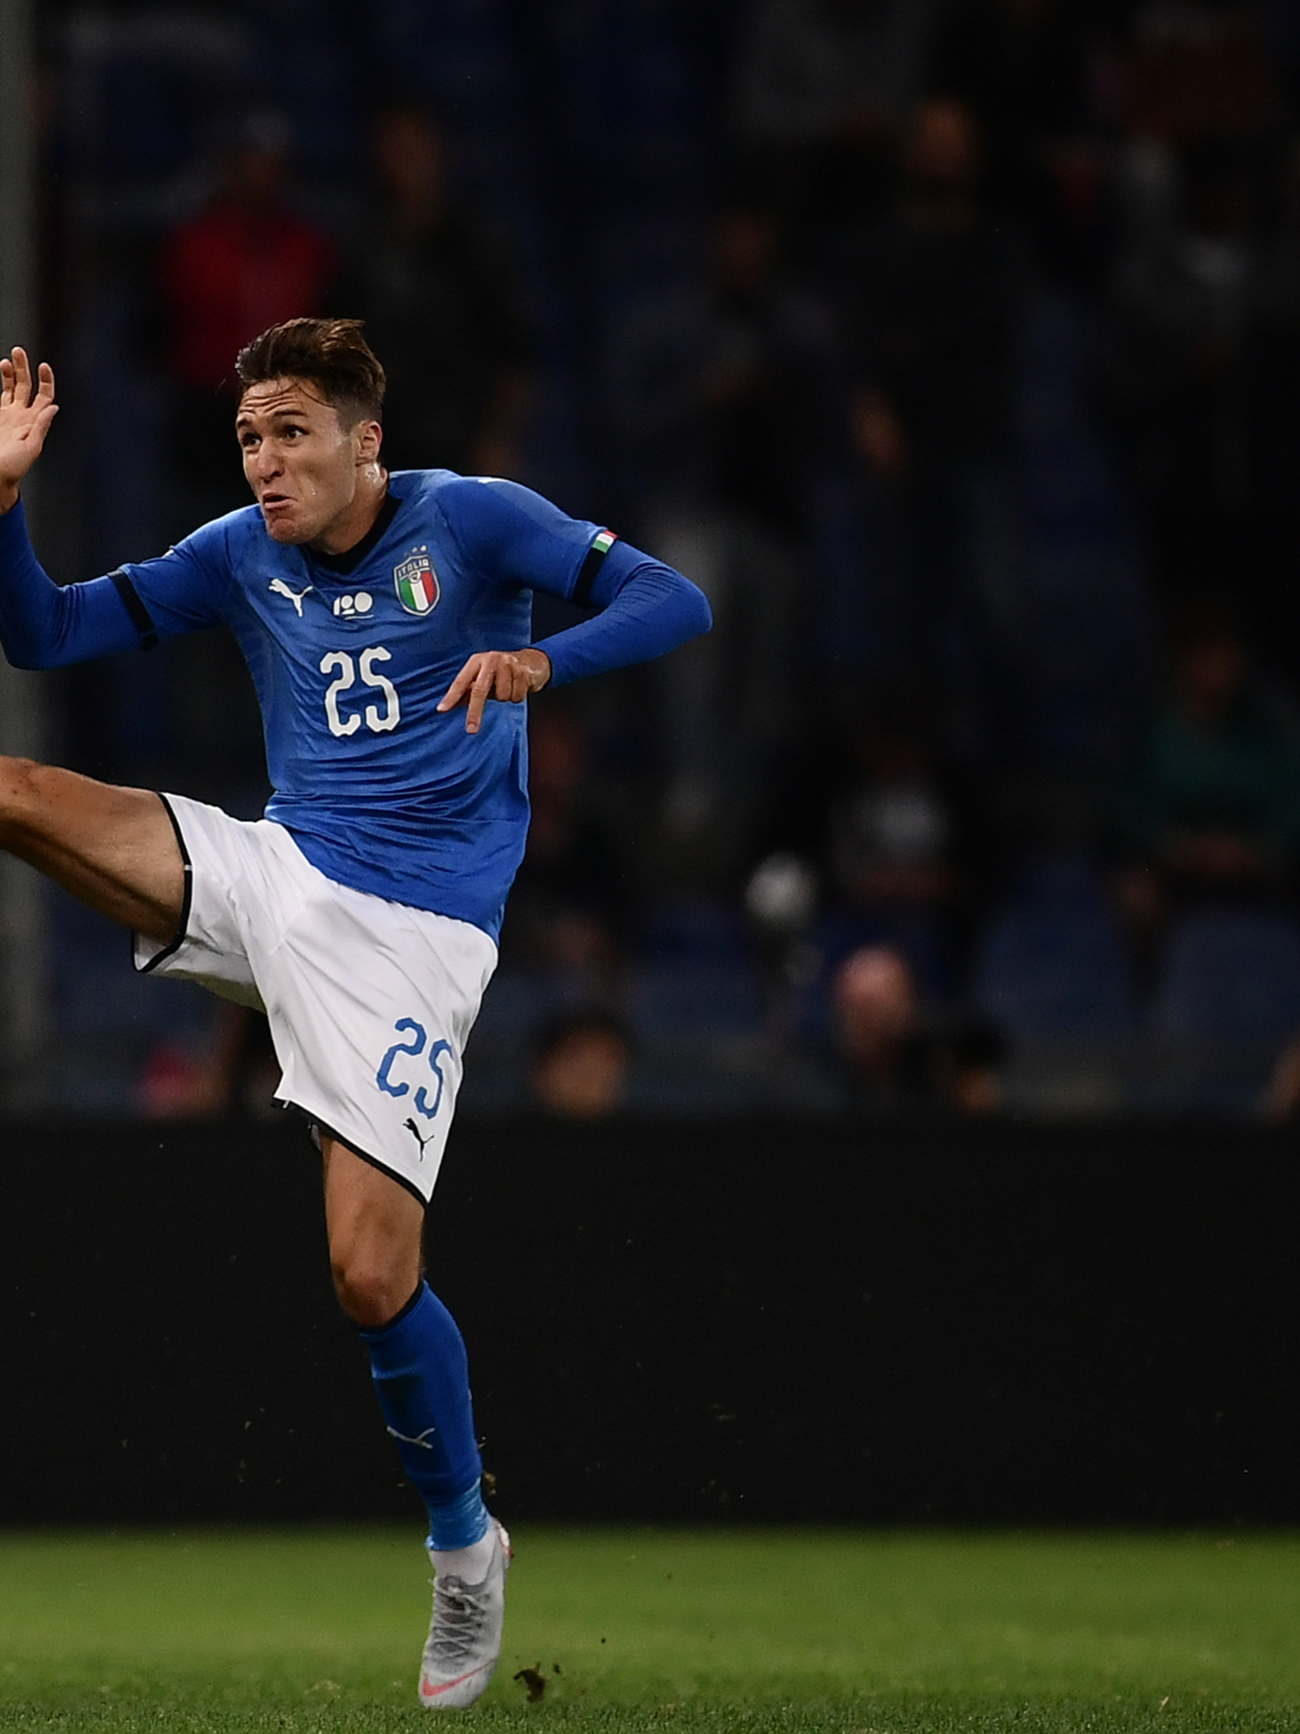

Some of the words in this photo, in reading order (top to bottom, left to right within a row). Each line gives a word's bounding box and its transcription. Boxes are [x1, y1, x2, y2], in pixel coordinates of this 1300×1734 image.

[398, 558, 430, 577] ITALIA
[319, 646, 400, 737] 25
[376, 1017, 455, 1119] 25
